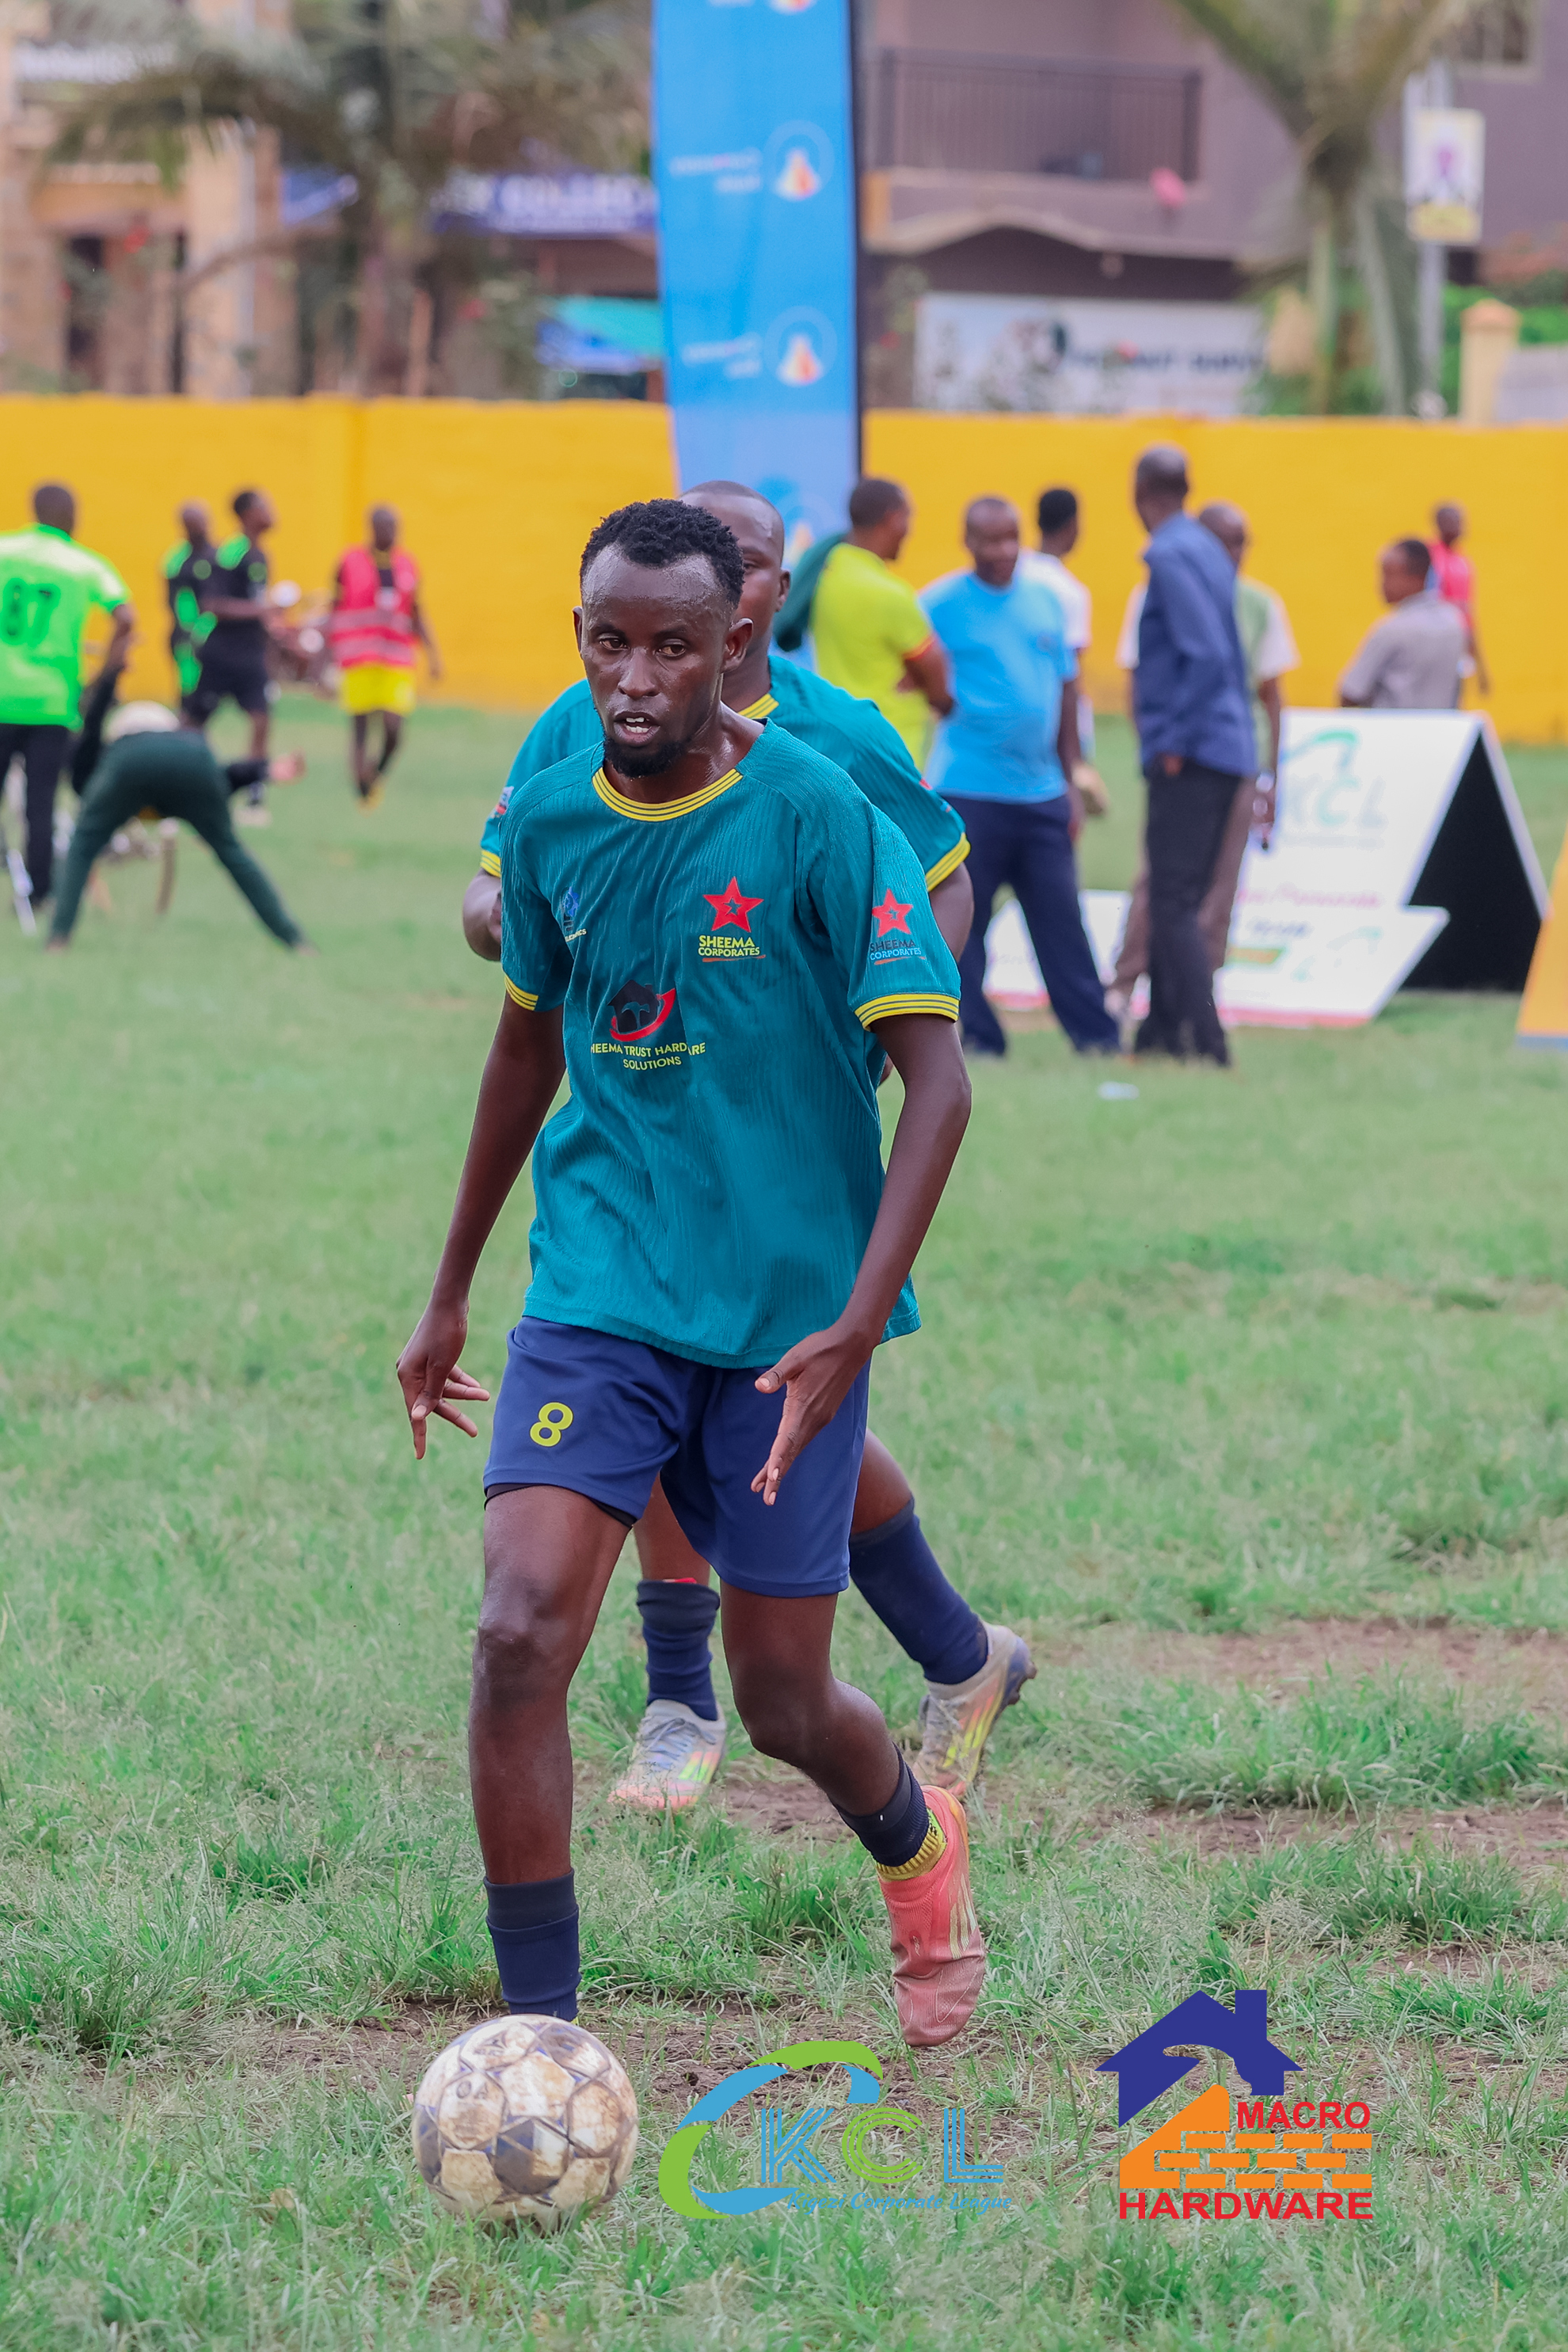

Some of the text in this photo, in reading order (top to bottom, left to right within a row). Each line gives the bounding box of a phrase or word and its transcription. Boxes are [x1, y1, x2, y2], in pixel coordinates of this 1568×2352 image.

[698, 935, 755, 948] SHEEMA
[870, 939, 915, 952] SHEEMA
[698, 947, 760, 957] CORPORATES
[870, 947, 922, 961] CORPORATES
[590, 1042, 706, 1057] HEEMA TRUST HARDRE
[622, 1056, 682, 1071] SOLUTIONS
[530, 1402, 573, 1447] 8
